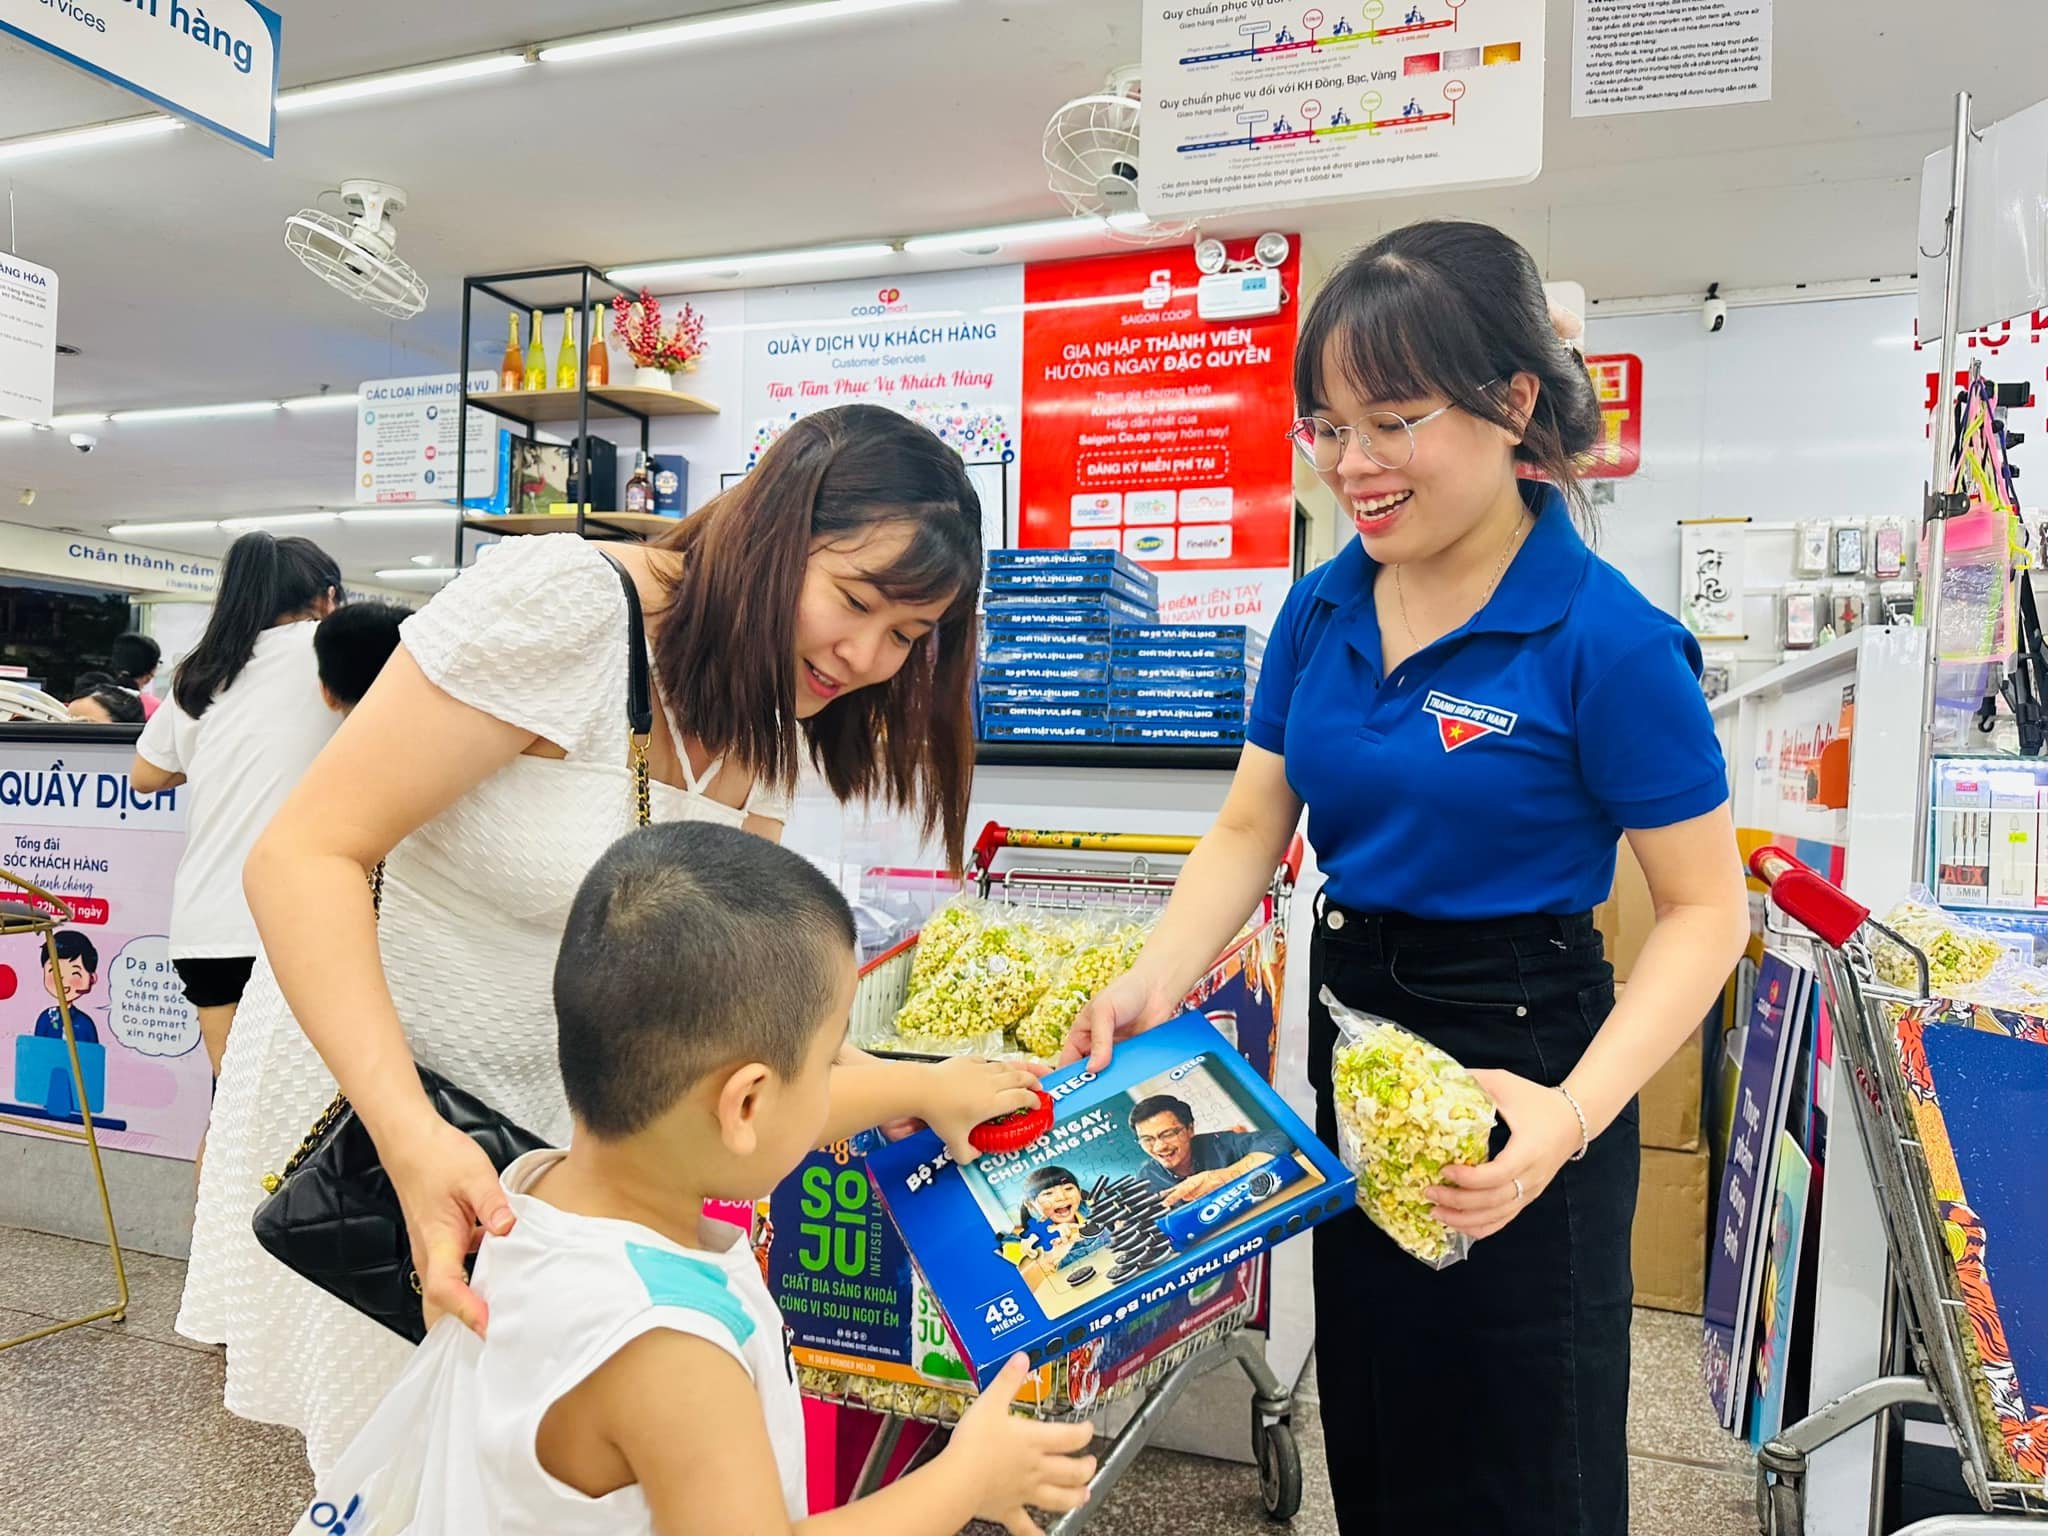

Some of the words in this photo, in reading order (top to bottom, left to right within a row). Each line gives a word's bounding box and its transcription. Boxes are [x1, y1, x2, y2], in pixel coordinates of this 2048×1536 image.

[1162, 9, 1183, 20] Quy
[1185, 3, 1218, 17] chuẩn
[1221, 0, 1248, 13] phục
[170, 0, 252, 73] hàng
[1179, 21, 1196, 29] Giao
[1160, 99, 1179, 110] Quy
[1182, 92, 1213, 106] chuẩn
[1216, 91, 1241, 104] phục
[1243, 90, 1257, 99] vụ
[1259, 85, 1276, 97] đối
[1278, 82, 1296, 94] với
[1297, 80, 1313, 92] KH
[1315, 76, 1345, 89] Đồng,
[1347, 74, 1369, 85] Bạc,
[1370, 70, 1397, 81] Vàng
[24, 270, 47, 287] HÓA
[1121, 311, 1160, 326] SAIGON
[768, 333, 811, 355] QUẦY
[816, 335, 854, 355] DỊCH
[858, 331, 880, 352] VỤ
[885, 325, 943, 347] KHÁCH
[948, 321, 997, 343] HÀNG
[1063, 344, 1091, 361] GIA
[1095, 336, 1142, 357] NHẬP
[1145, 330, 1207, 353] THÀNH
[1210, 327, 1253, 347] VIÊN
[832, 356, 880, 369] Customer
[882, 354, 927, 367] Services
[1045, 360, 1110, 381] HƯỞNG
[1114, 357, 1161, 375] NGAY
[1163, 351, 1203, 373] ĐẶC
[1206, 343, 1271, 368] QUYỀN
[366, 387, 388, 401] CÁC
[390, 384, 415, 401] LOẠI
[417, 382, 443, 397] HÌNH
[835, 377, 869, 398] Phục
[875, 375, 896, 396] Vụ
[900, 371, 948, 391] Khách
[952, 369, 994, 389] Hàng
[1079, 432, 1116, 447] Saigon
[1118, 430, 1151, 444] Co.op
[1152, 430, 1178, 442] ngay
[1180, 427, 1205, 439] hôm
[1087, 459, 1121, 476] ĐĂNG
[1122, 459, 1140, 474] KÝ
[1140, 456, 1172, 473] MIỄN
[1173, 455, 1195, 473] PHÍ
[1195, 456, 1216, 472] TẠI
[69, 543, 118, 563] Chân
[124, 552, 175, 573] thành
[1167, 594, 1198, 611] ĐIỂM
[1236, 581, 1263, 598] TAY
[1174, 609, 1202, 624] NGAY
[1207, 605, 1231, 618] ƯU
[1234, 597, 1262, 616] ĐÃI
[1486, 711, 1510, 729] NAM
[0, 759, 88, 808] QUẦY
[97, 773, 177, 820] DỊCH
[15, 835, 41, 852] Tổng
[44, 837, 61, 851] đài
[4, 851, 28, 868] SÓC
[30, 853, 71, 870] KHÁCH
[73, 855, 109, 873] HÀNG
[1942, 865, 1985, 885] AUX
[78, 904, 103, 921] ngày
[126, 957, 147, 974] Dạ
[125, 989, 159, 1002] Chăm
[163, 993, 186, 1004] sóc
[131, 976, 159, 991] tổng
[121, 1001, 155, 1013] khách
[159, 1004, 188, 1019] hàng
[122, 1013, 187, 1031] Co.opmart
[127, 1028, 144, 1038] xin
[148, 1030, 182, 1042] nghe!
[1169, 1055, 1206, 1080] OREO
[1051, 1069, 1100, 1102] REO
[1744, 1087, 1761, 1132] Thực
[1052, 1107, 1109, 1141] NGAY.
[986, 1161, 1029, 1186] CHƠI
[1083, 1121, 1119, 1144] SAY.
[1734, 1128, 1754, 1179] phẩm
[906, 1163, 934, 1193] Bộ
[1198, 1182, 1251, 1224] OREO
[1727, 1173, 1747, 1229] đông
[799, 1222, 867, 1277] JU
[869, 1222, 884, 1277] INFUSED
[1223, 1236, 1264, 1266] CHƠI
[1722, 1215, 1739, 1264] lạnh
[1178, 1259, 1222, 1287] THẬT
[782, 1271, 810, 1291] CHẤT
[812, 1277, 831, 1295] BIA
[832, 1279, 861, 1300] SẢNG
[864, 1285, 898, 1305] KHOÁI
[1141, 1281, 1177, 1304] VUI,
[779, 1292, 808, 1312] CÙNG
[811, 1300, 822, 1318] VỊ
[823, 1303, 851, 1321] SOJU
[853, 1307, 880, 1326] NGỌT
[883, 1308, 900, 1328] ÊM
[983, 1297, 1020, 1326] 48
[1113, 1298, 1141, 1322] BỐ
[990, 1313, 1026, 1336] MIẾNG
